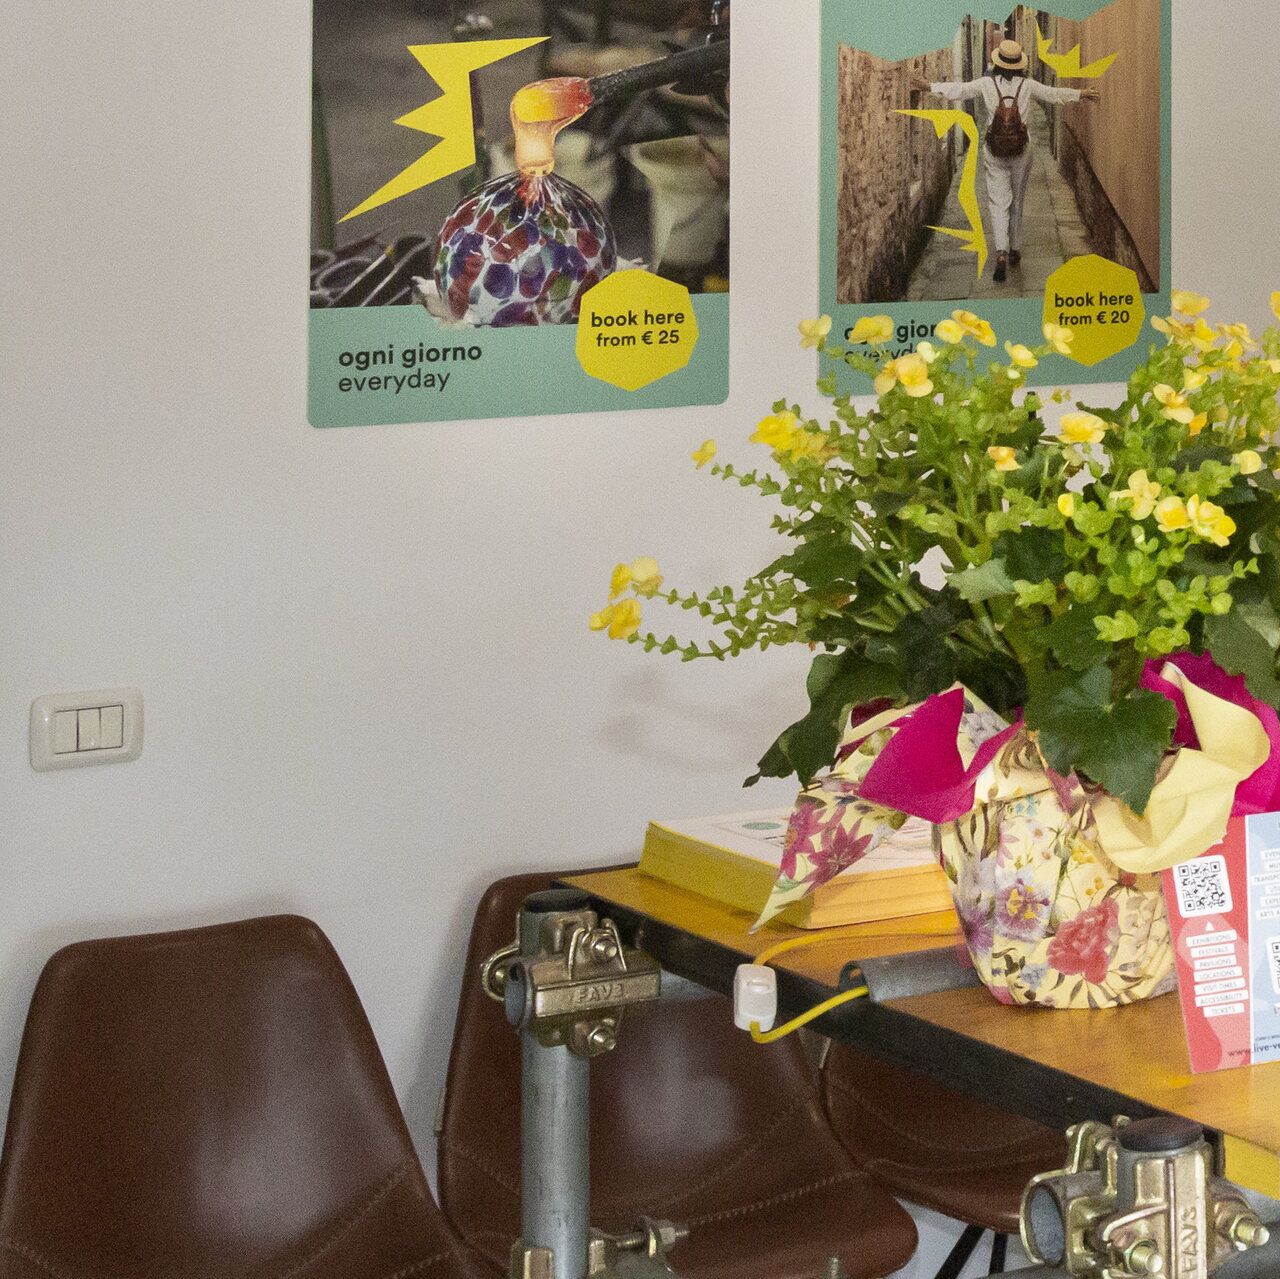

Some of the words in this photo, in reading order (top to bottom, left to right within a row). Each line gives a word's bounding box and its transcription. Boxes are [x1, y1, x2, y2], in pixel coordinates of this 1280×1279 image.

[1054, 293, 1094, 308] book
[1099, 292, 1133, 305] here
[591, 311, 637, 327] book
[644, 309, 685, 325] here
[1058, 314, 1092, 326] from
[1097, 312, 1106, 324] €
[1111, 311, 1130, 324] 20
[596, 332, 635, 347] from
[641, 332, 653, 345] €
[659, 329, 679, 344] 25
[339, 345, 393, 369] ogni
[402, 342, 482, 367] giorno
[338, 371, 451, 394] everyday
